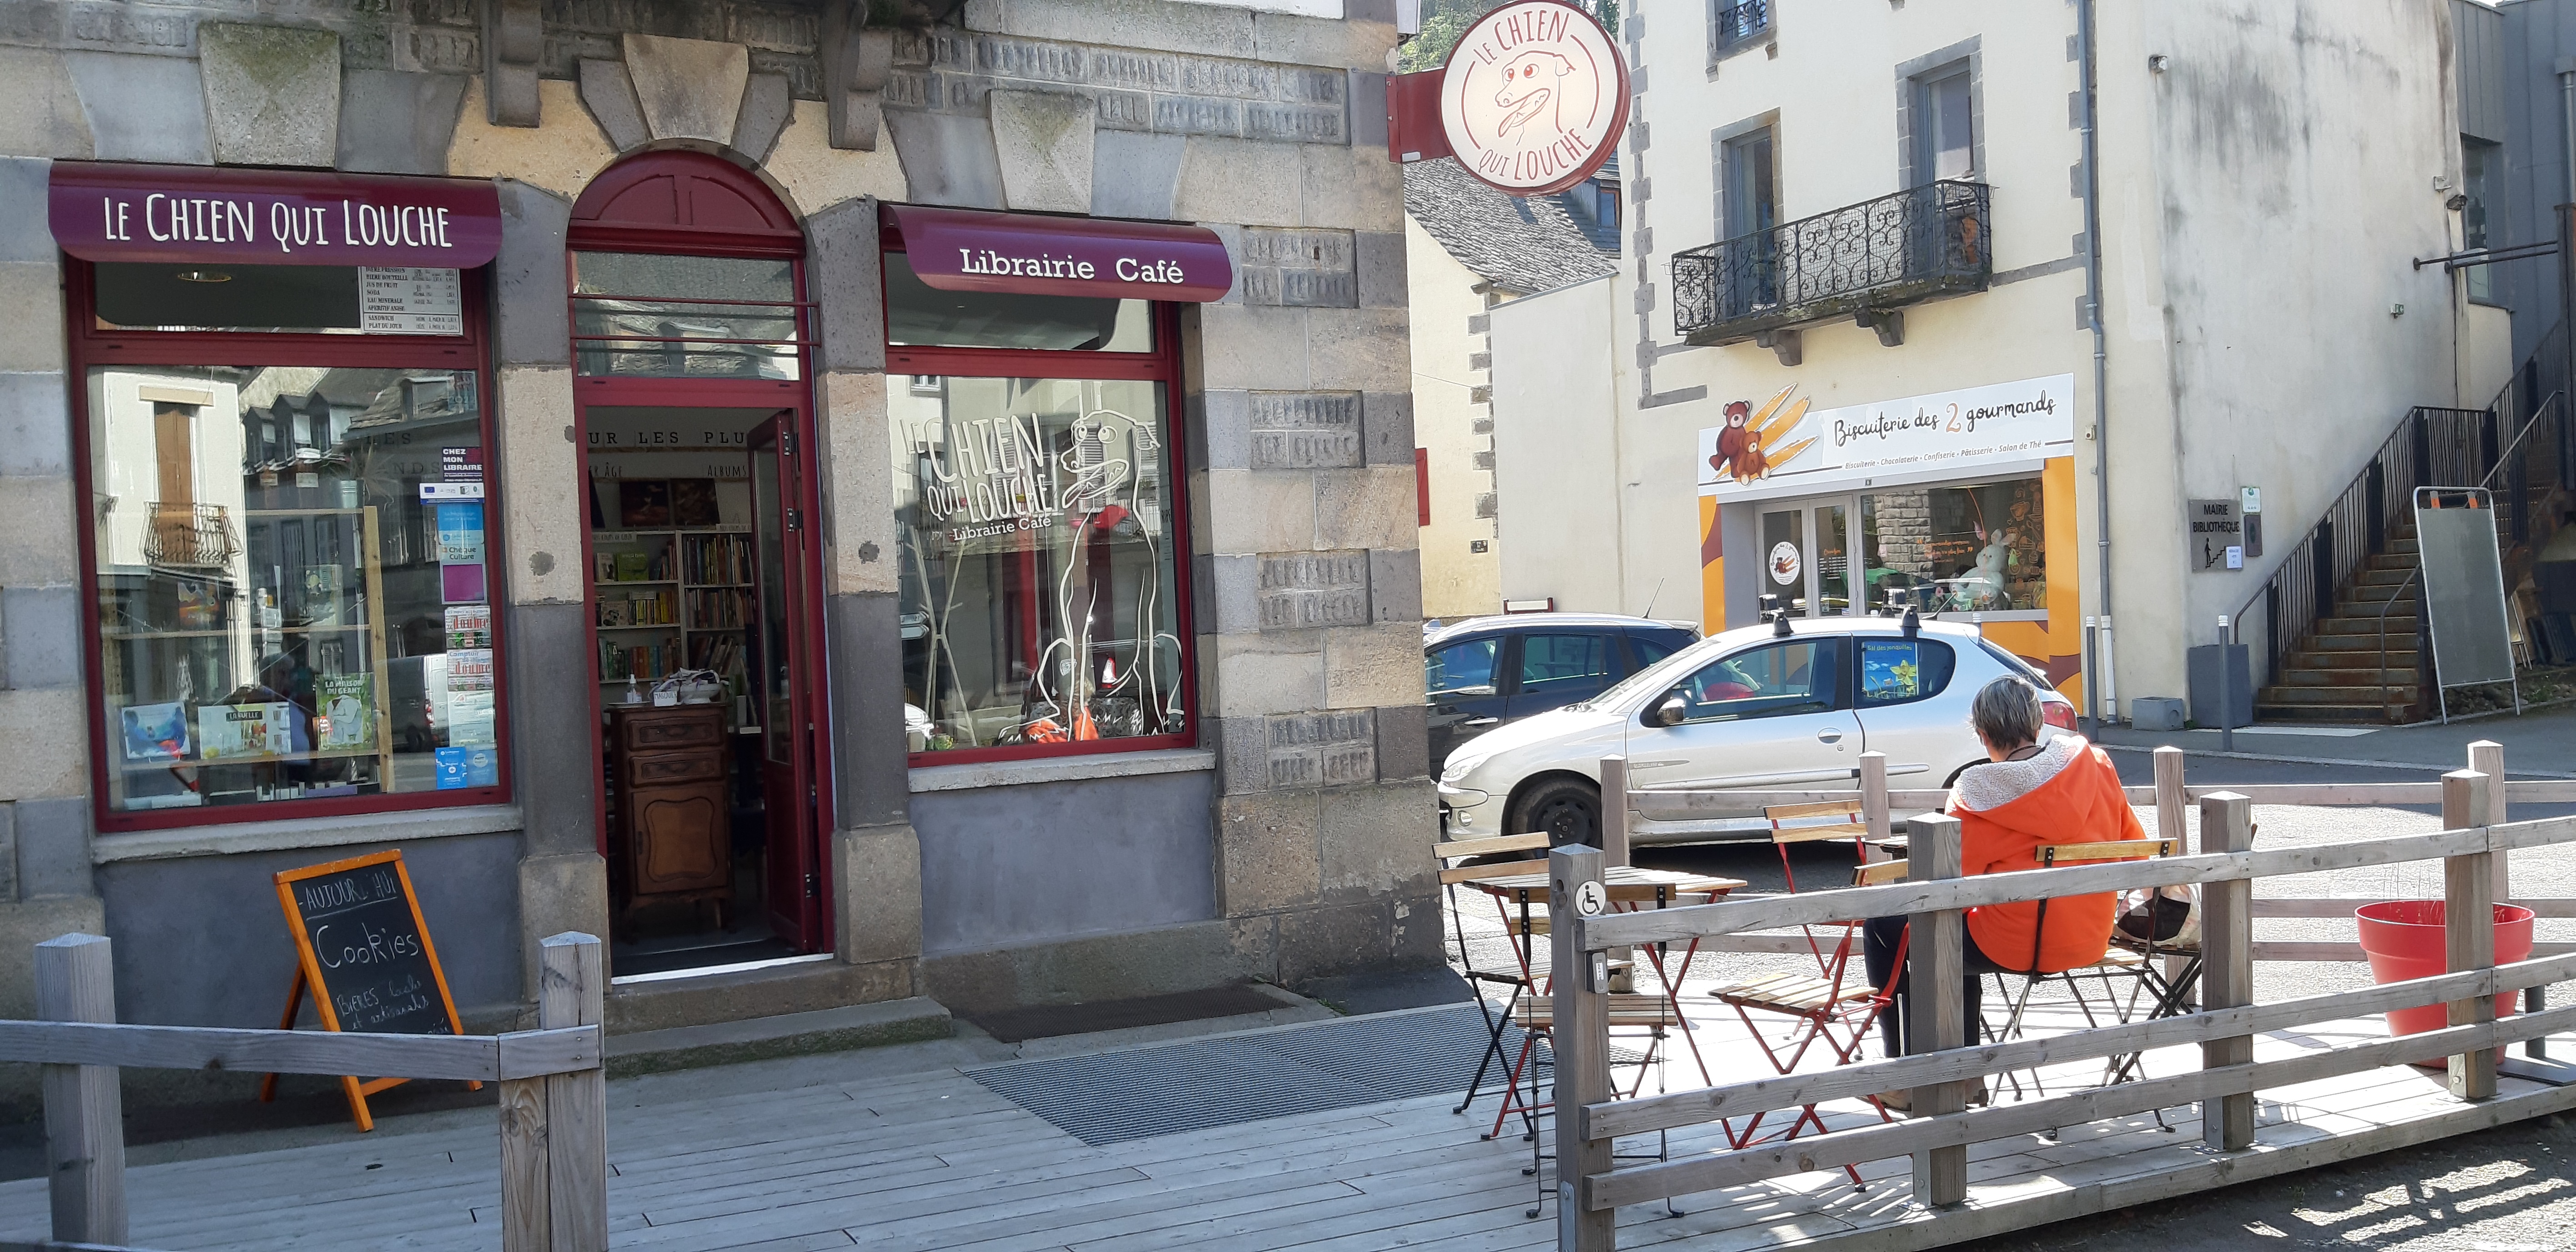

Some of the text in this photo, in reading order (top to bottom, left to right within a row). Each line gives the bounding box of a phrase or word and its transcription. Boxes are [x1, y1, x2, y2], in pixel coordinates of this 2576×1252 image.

[1473, 10, 1569, 65] LE CHIEN
[1478, 128, 1592, 181] QUI LOUCHE
[104, 193, 453, 253] LE CHIEN QUI LOUCHE
[958, 247, 1184, 284] Librairie Café
[639, 432, 679, 444] LES
[1834, 389, 2057, 447] Biscuiterie des 2 gourmands
[899, 413, 1045, 482] LE CHIEN
[1845, 460, 1876, 469] Biscuiterie
[1881, 455, 1919, 465] Chocolaterie
[1923, 451, 1956, 462] Confiserie
[1961, 447, 1993, 457] Pâtisserie
[1998, 444, 2018, 453] Salon
[2029, 439, 2042, 449] Thé
[707, 464, 747, 477] ALBUMS
[926, 473, 1052, 524] QUI LOUCHE
[2204, 504, 2229, 515] MAIRIE
[953, 515, 1052, 542] Librairie Café
[2193, 518, 2240, 534] BIBLIOTHÈQUE
[316, 922, 419, 969] Cookies
